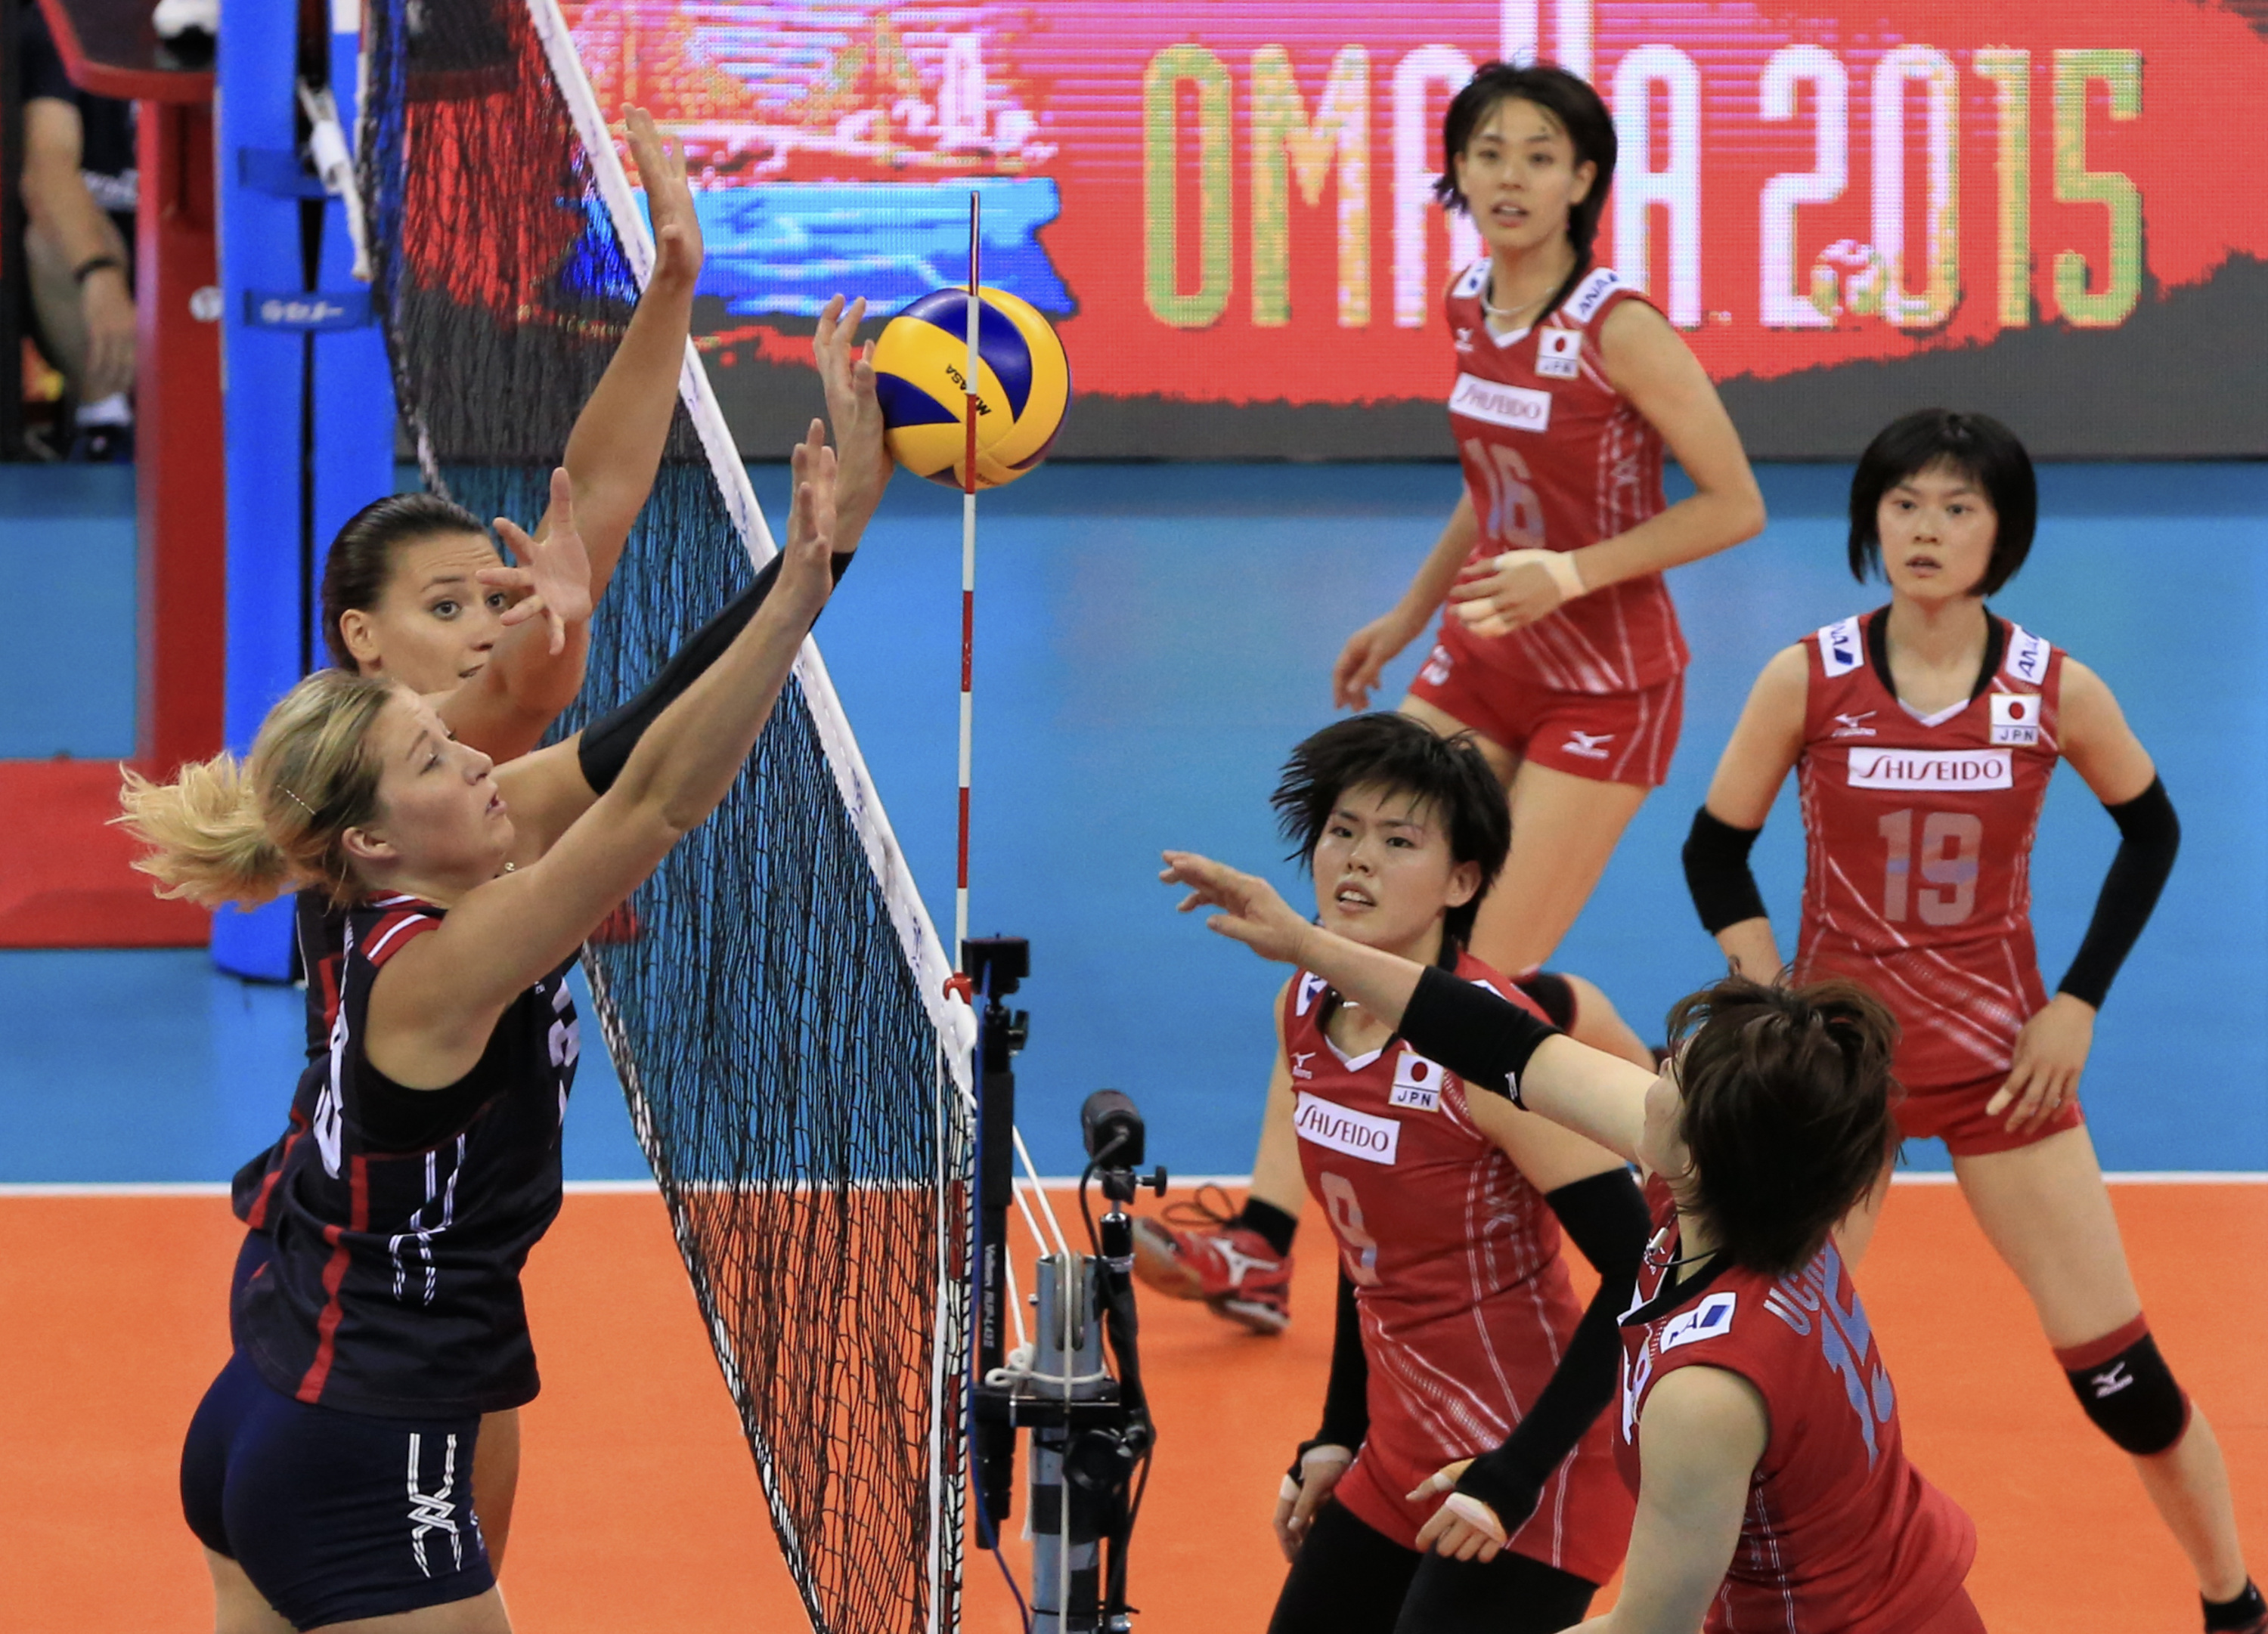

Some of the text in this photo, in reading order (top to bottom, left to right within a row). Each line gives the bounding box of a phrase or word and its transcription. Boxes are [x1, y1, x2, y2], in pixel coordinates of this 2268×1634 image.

[1143, 2, 2143, 330] OMAA 2015
[1579, 279, 1610, 315] ANA
[945, 364, 993, 416] MASA
[1464, 438, 1546, 549] 16
[2000, 728, 2034, 742] JPN
[1857, 755, 2004, 781] SHISEIDO
[1878, 807, 1984, 927] 19
[1397, 1090, 1432, 1106] JPN
[1297, 1104, 1390, 1153] SHISEIDO
[1320, 1171, 1383, 1286] 9
